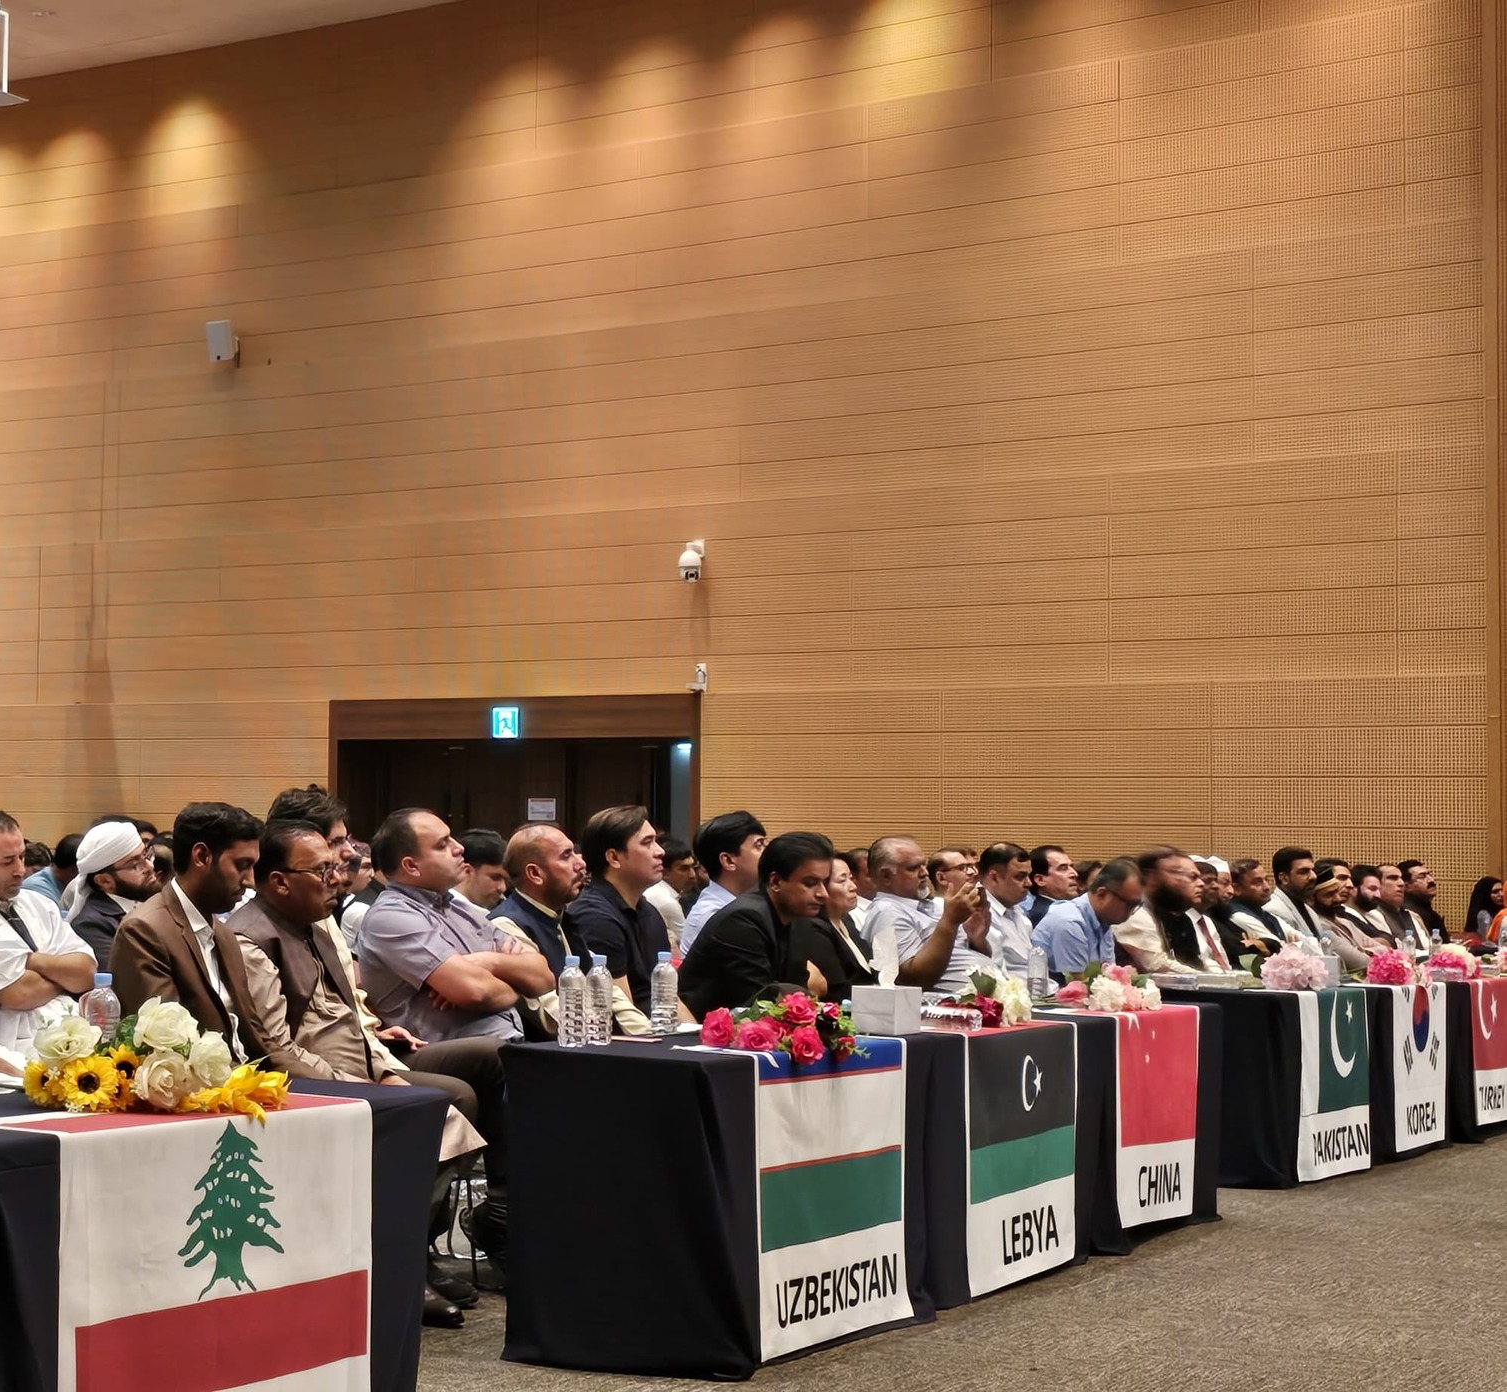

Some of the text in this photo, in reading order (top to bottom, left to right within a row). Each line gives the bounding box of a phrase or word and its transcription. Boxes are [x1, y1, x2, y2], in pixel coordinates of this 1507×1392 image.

[1406, 1101, 1437, 1136] KOREA
[1138, 1162, 1181, 1207] CHINA
[1002, 1204, 1059, 1265] LEBYA
[776, 1253, 897, 1328] UZBEKISTAN
